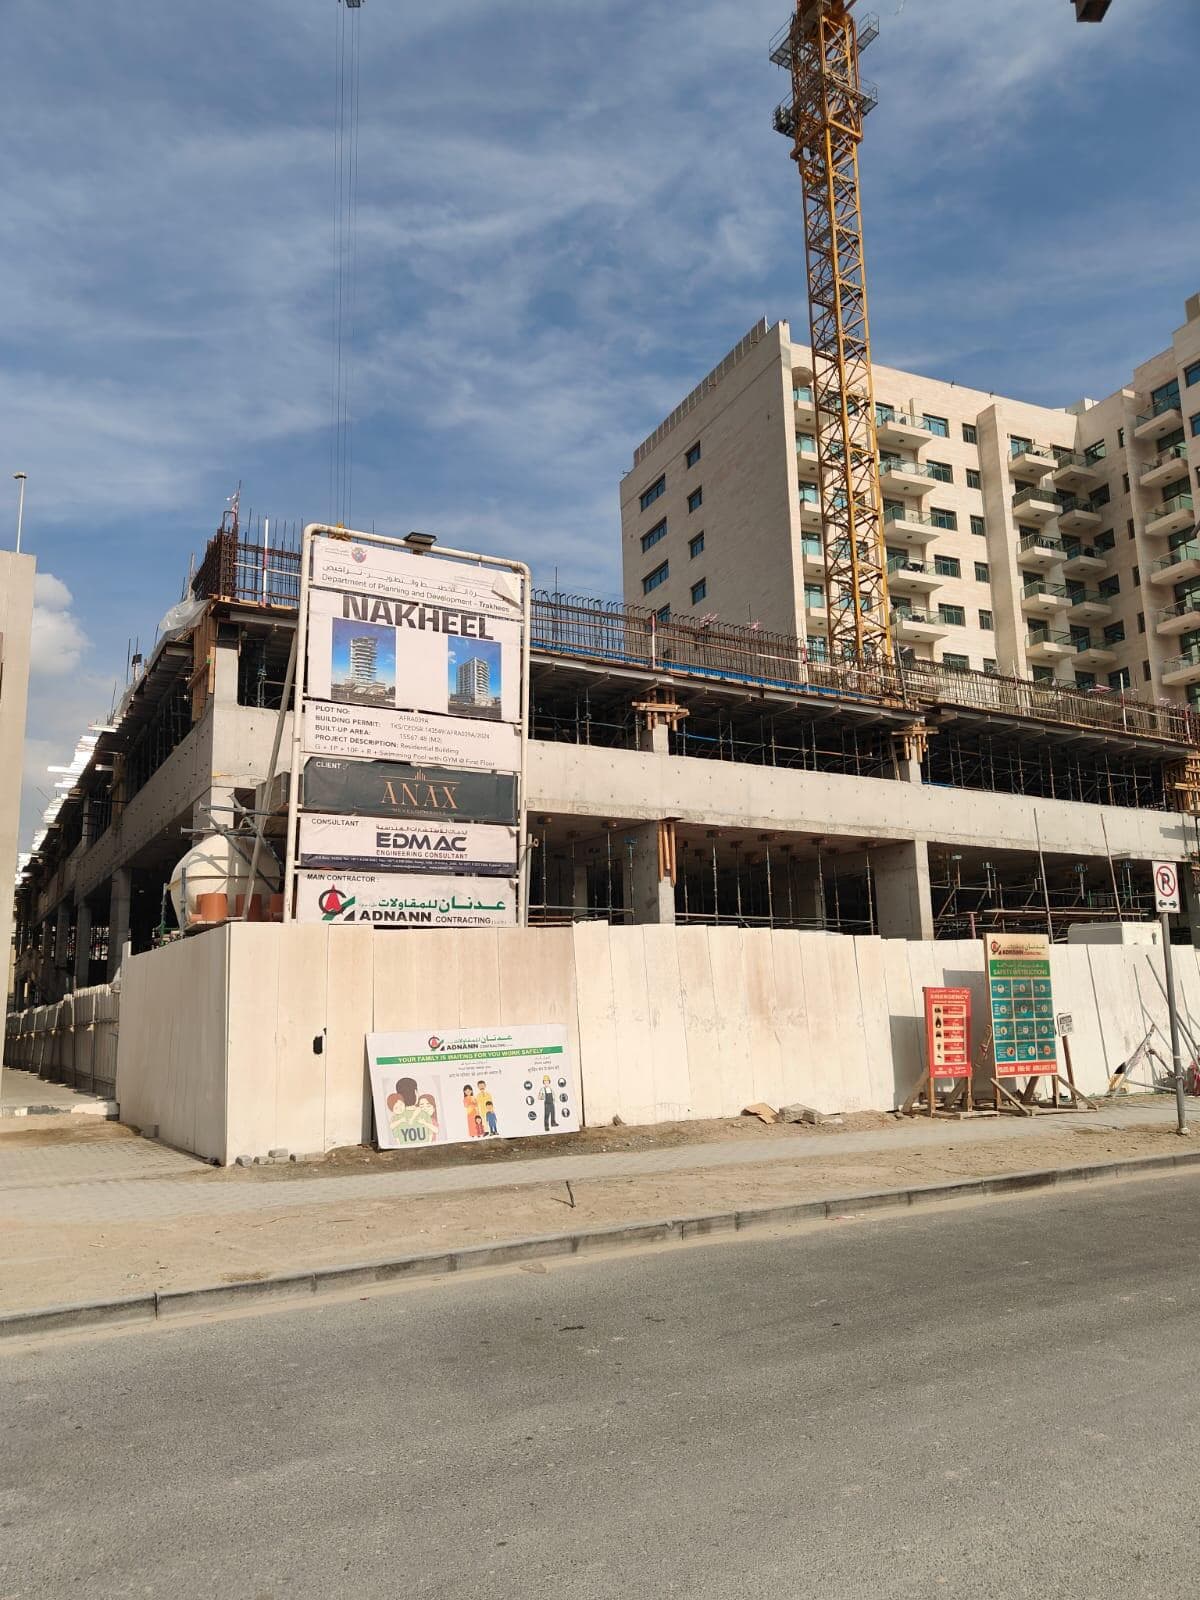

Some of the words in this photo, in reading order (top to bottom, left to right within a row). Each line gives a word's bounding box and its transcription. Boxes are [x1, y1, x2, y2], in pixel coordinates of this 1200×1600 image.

[322, 574, 367, 587] Department
[369, 581, 376, 589] of
[378, 583, 409, 596] Planning
[412, 590, 424, 598] and
[427, 591, 472, 606] Development
[342, 596, 494, 640] NAKHEEL
[315, 705, 334, 713] PLOT
[315, 715, 351, 724] BUILDING
[315, 724, 348, 733] BUILT-UP
[315, 734, 348, 743] PROJECT
[400, 742, 434, 752] Residential
[435, 746, 459, 755] Building
[315, 761, 340, 769] CLIENT
[381, 781, 460, 809] ANAX
[311, 818, 360, 827] CONSULTANT
[376, 832, 467, 852] EDMAC
[376, 850, 422, 858] ENGINEERING
[425, 851, 468, 859] CONSULTANT
[307, 873, 325, 881] MAIN
[327, 874, 376, 883] CONTRACTOR
[378, 897, 437, 911] للمقاولات
[439, 896, 506, 913] عدنان
[360, 910, 432, 922] ADNANN
[435, 915, 491, 925] CONTRACTING
[446, 1043, 479, 1051] ADNANN
[398, 1056, 416, 1064] YOUR
[418, 1055, 440, 1063] FAMILY
[474, 1052, 487, 1060] FOR
[521, 1048, 544, 1056] SAFELY
[401, 1127, 426, 1142] YOU
